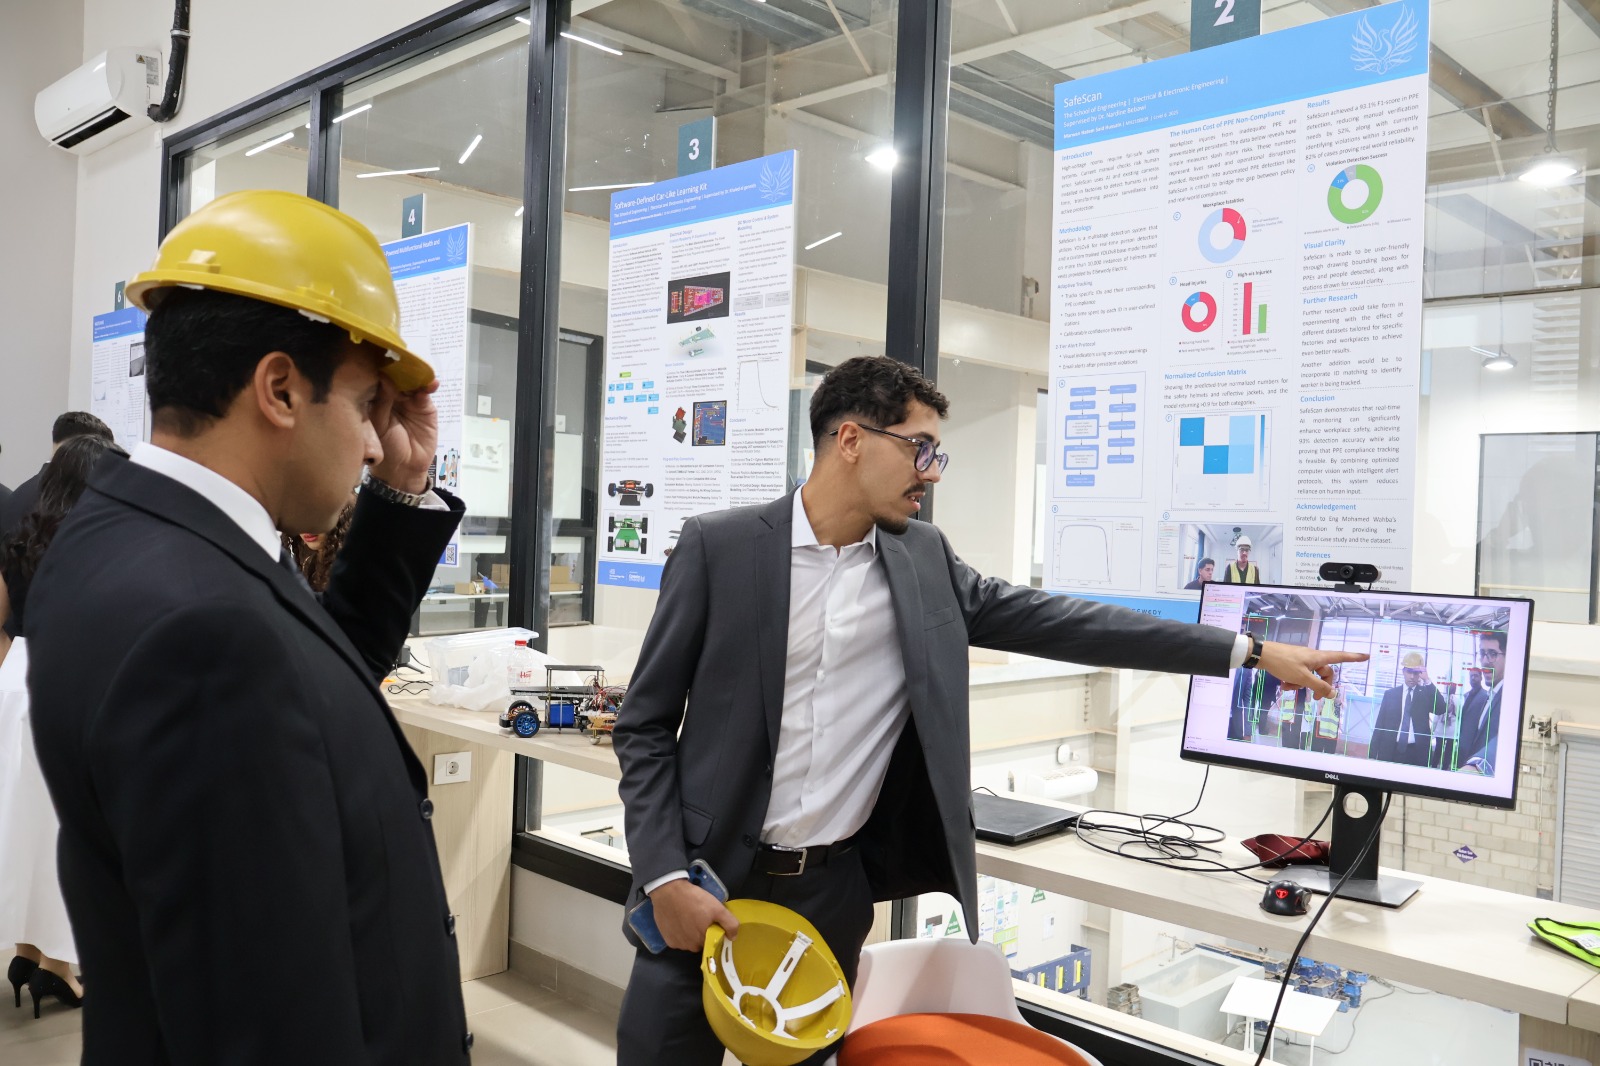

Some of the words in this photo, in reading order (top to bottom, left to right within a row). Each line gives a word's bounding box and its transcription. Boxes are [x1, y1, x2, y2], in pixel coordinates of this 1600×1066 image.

[1213, 0, 1234, 26] 2
[1064, 93, 1102, 107] SafeScan
[1074, 108, 1090, 117] School
[1097, 101, 1127, 113] Engineering
[1133, 93, 1156, 104] Electrical
[1164, 86, 1190, 97] Electronic
[1191, 80, 1224, 92] Engineering
[1307, 99, 1330, 109] Results
[1307, 112, 1329, 120] SafeScan
[1331, 105, 1354, 116] achieved
[1360, 101, 1376, 110] 93.1%
[1378, 98, 1400, 107] F1-score
[1182, 127, 1201, 136] Human
[1203, 123, 1215, 131] Cost
[1224, 119, 1234, 127] PPE
[1236, 110, 1285, 124] Non-Compliance
[1306, 121, 1332, 130] detection,
[1336, 116, 1360, 125] reducing
[1364, 110, 1384, 119] manual
[1388, 104, 1419, 115] verification
[1306, 132, 1322, 140] needs
[1376, 120, 1388, 128] with
[1393, 114, 1418, 124] currently
[1306, 140, 1333, 150] identifying
[1335, 136, 1360, 145] violations
[1363, 132, 1380, 140] within
[1388, 126, 1410, 136] seconds
[688, 138, 700, 160] 3
[1339, 147, 1359, 157] proving
[1372, 141, 1388, 149] world
[1389, 137, 1416, 147] reliability.
[1062, 151, 1092, 161] Introduction
[615, 194, 655, 209] Software-Defined
[656, 191, 676, 200] Car-Like
[677, 186, 699, 196] Learning
[408, 209, 416, 225] 4
[1060, 226, 1091, 234] Methodology
[1304, 241, 1323, 250] Visual
[1325, 238, 1345, 247] Clarity
[1374, 243, 1410, 253] user-friendly
[1366, 277, 1384, 285] clarity.
[118, 290, 121, 302] 6
[1303, 296, 1326, 305] Further
[1328, 293, 1358, 302] Research
[1325, 306, 1347, 314] research
[1165, 371, 1196, 379] Normalized
[1347, 488, 1362, 496] input.
[1297, 503, 1356, 512] Acknowledgement
[1329, 516, 1339, 524] Eng
[1352, 526, 1378, 535] providing
[1333, 536, 1347, 545] study
